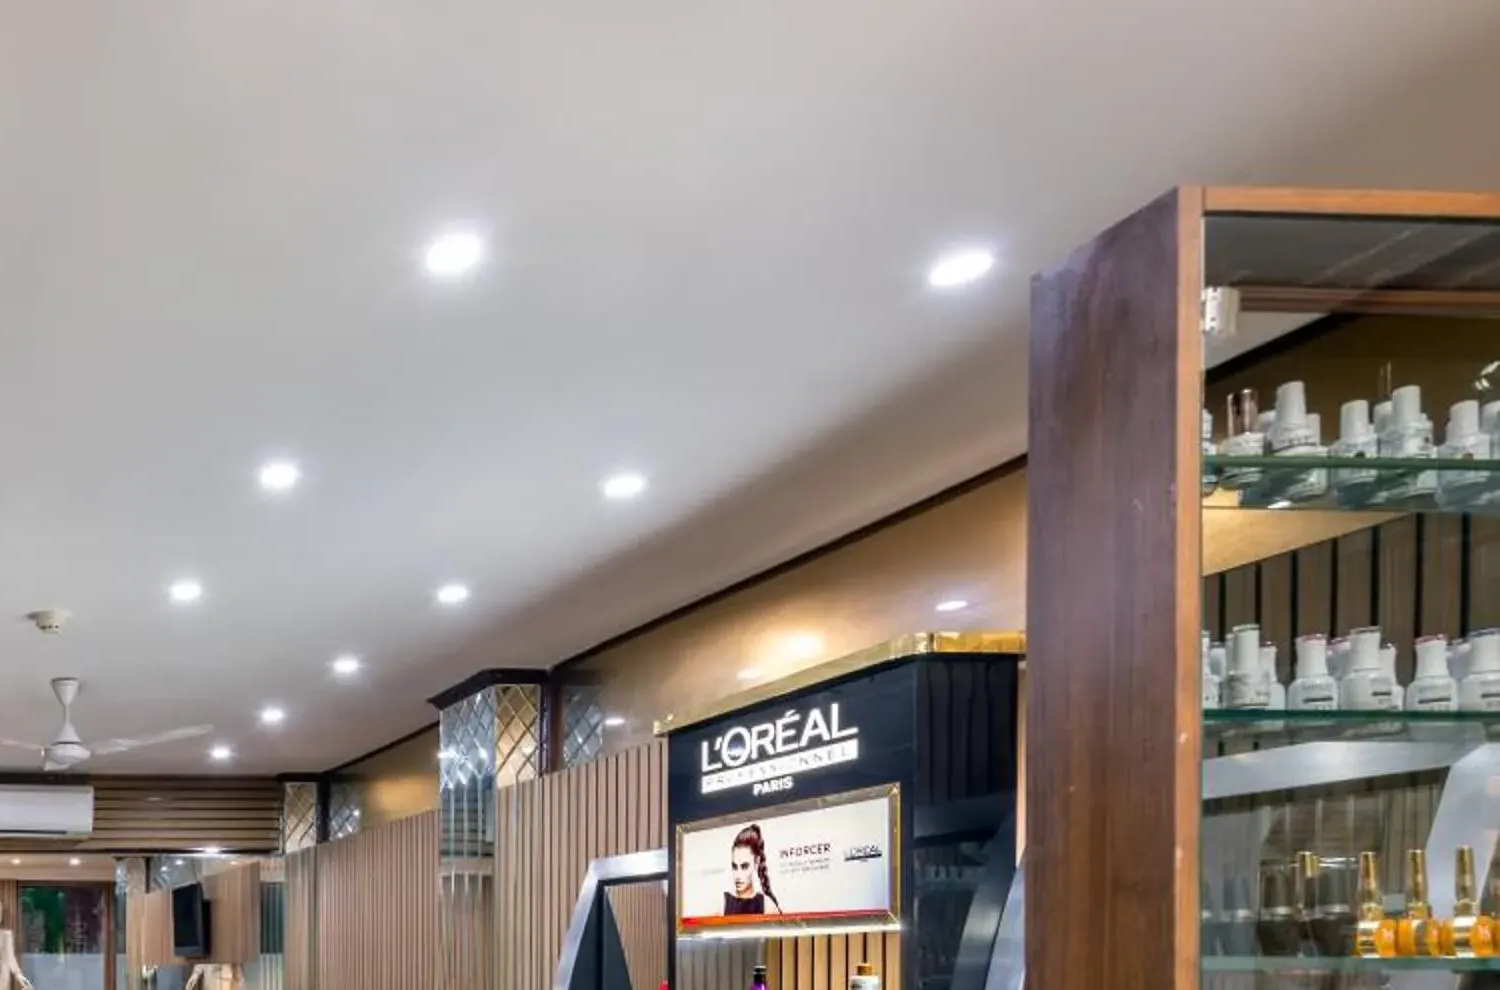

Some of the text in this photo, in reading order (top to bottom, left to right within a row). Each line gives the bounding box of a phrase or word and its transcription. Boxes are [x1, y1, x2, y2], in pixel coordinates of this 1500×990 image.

[701, 703, 859, 772] L'ORÉAL
[703, 741, 857, 791] PRFESSNNEL
[752, 775, 794, 796] PARIS
